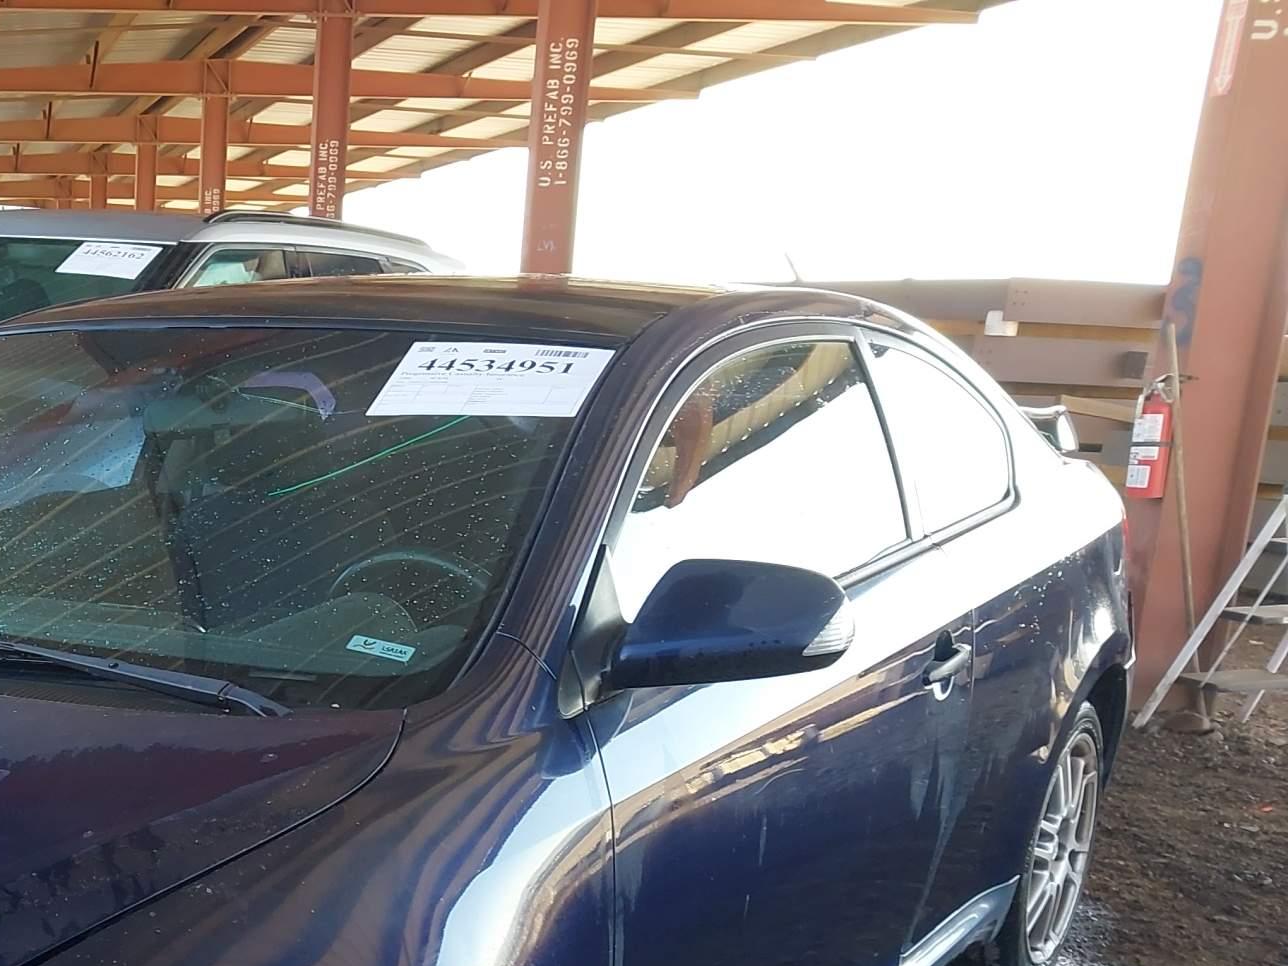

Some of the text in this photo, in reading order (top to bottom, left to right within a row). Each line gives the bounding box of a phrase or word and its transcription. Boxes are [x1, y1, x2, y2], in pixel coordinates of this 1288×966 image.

[549, 37, 564, 69] INC.
[542, 79, 560, 145] PREFAB
[554, 38, 579, 185] 1-866-799-0969
[316, 139, 328, 211] PREFAB INC.
[417, 357, 575, 375] 44534951
